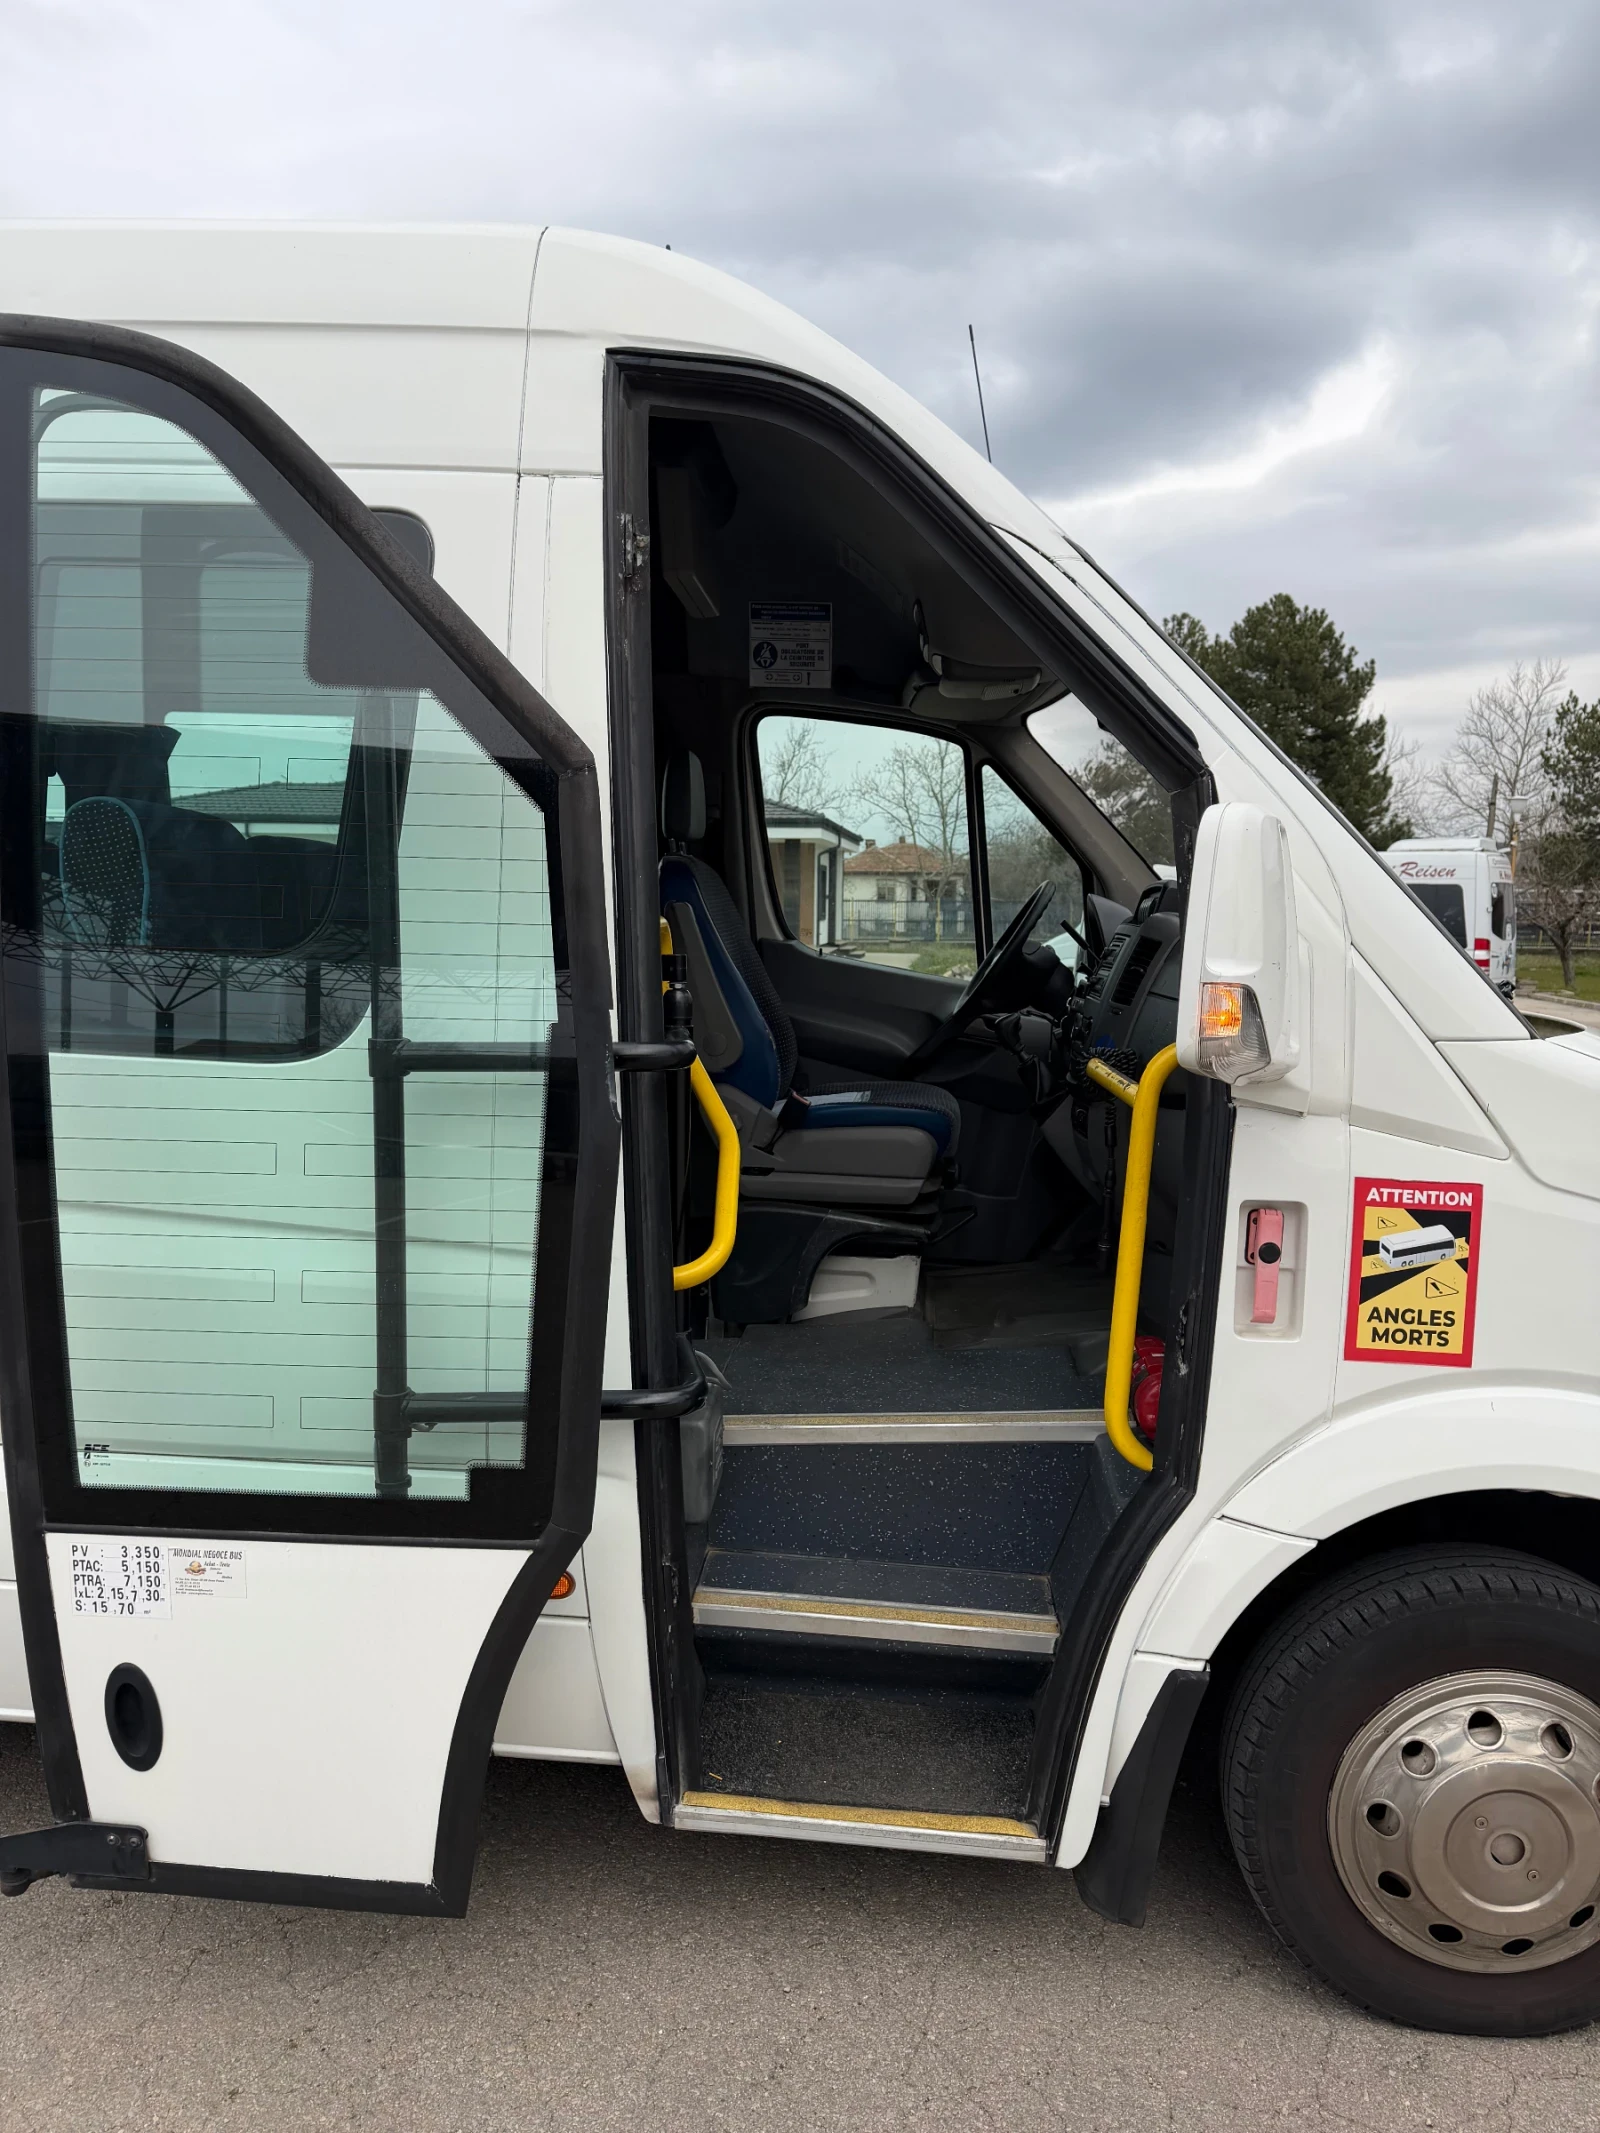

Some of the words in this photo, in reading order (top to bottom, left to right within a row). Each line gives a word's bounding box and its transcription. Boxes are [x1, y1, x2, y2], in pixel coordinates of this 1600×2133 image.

[1399, 861, 1456, 878] Reisen
[1366, 1187, 1473, 1207] ATTENTION
[1367, 1306, 1456, 1328] ANGLES
[1371, 1326, 1450, 1347] MORTS
[121, 1545, 160, 1560] 3,350
[172, 1548, 202, 1558] MONDIAL
[202, 1550, 228, 1560] NEGOCE
[229, 1551, 243, 1560] BUS
[72, 1560, 104, 1572] PTAC:
[121, 1560, 160, 1575] 5,150
[73, 1574, 106, 1587] PTRA:
[123, 1574, 161, 1589] 7,150
